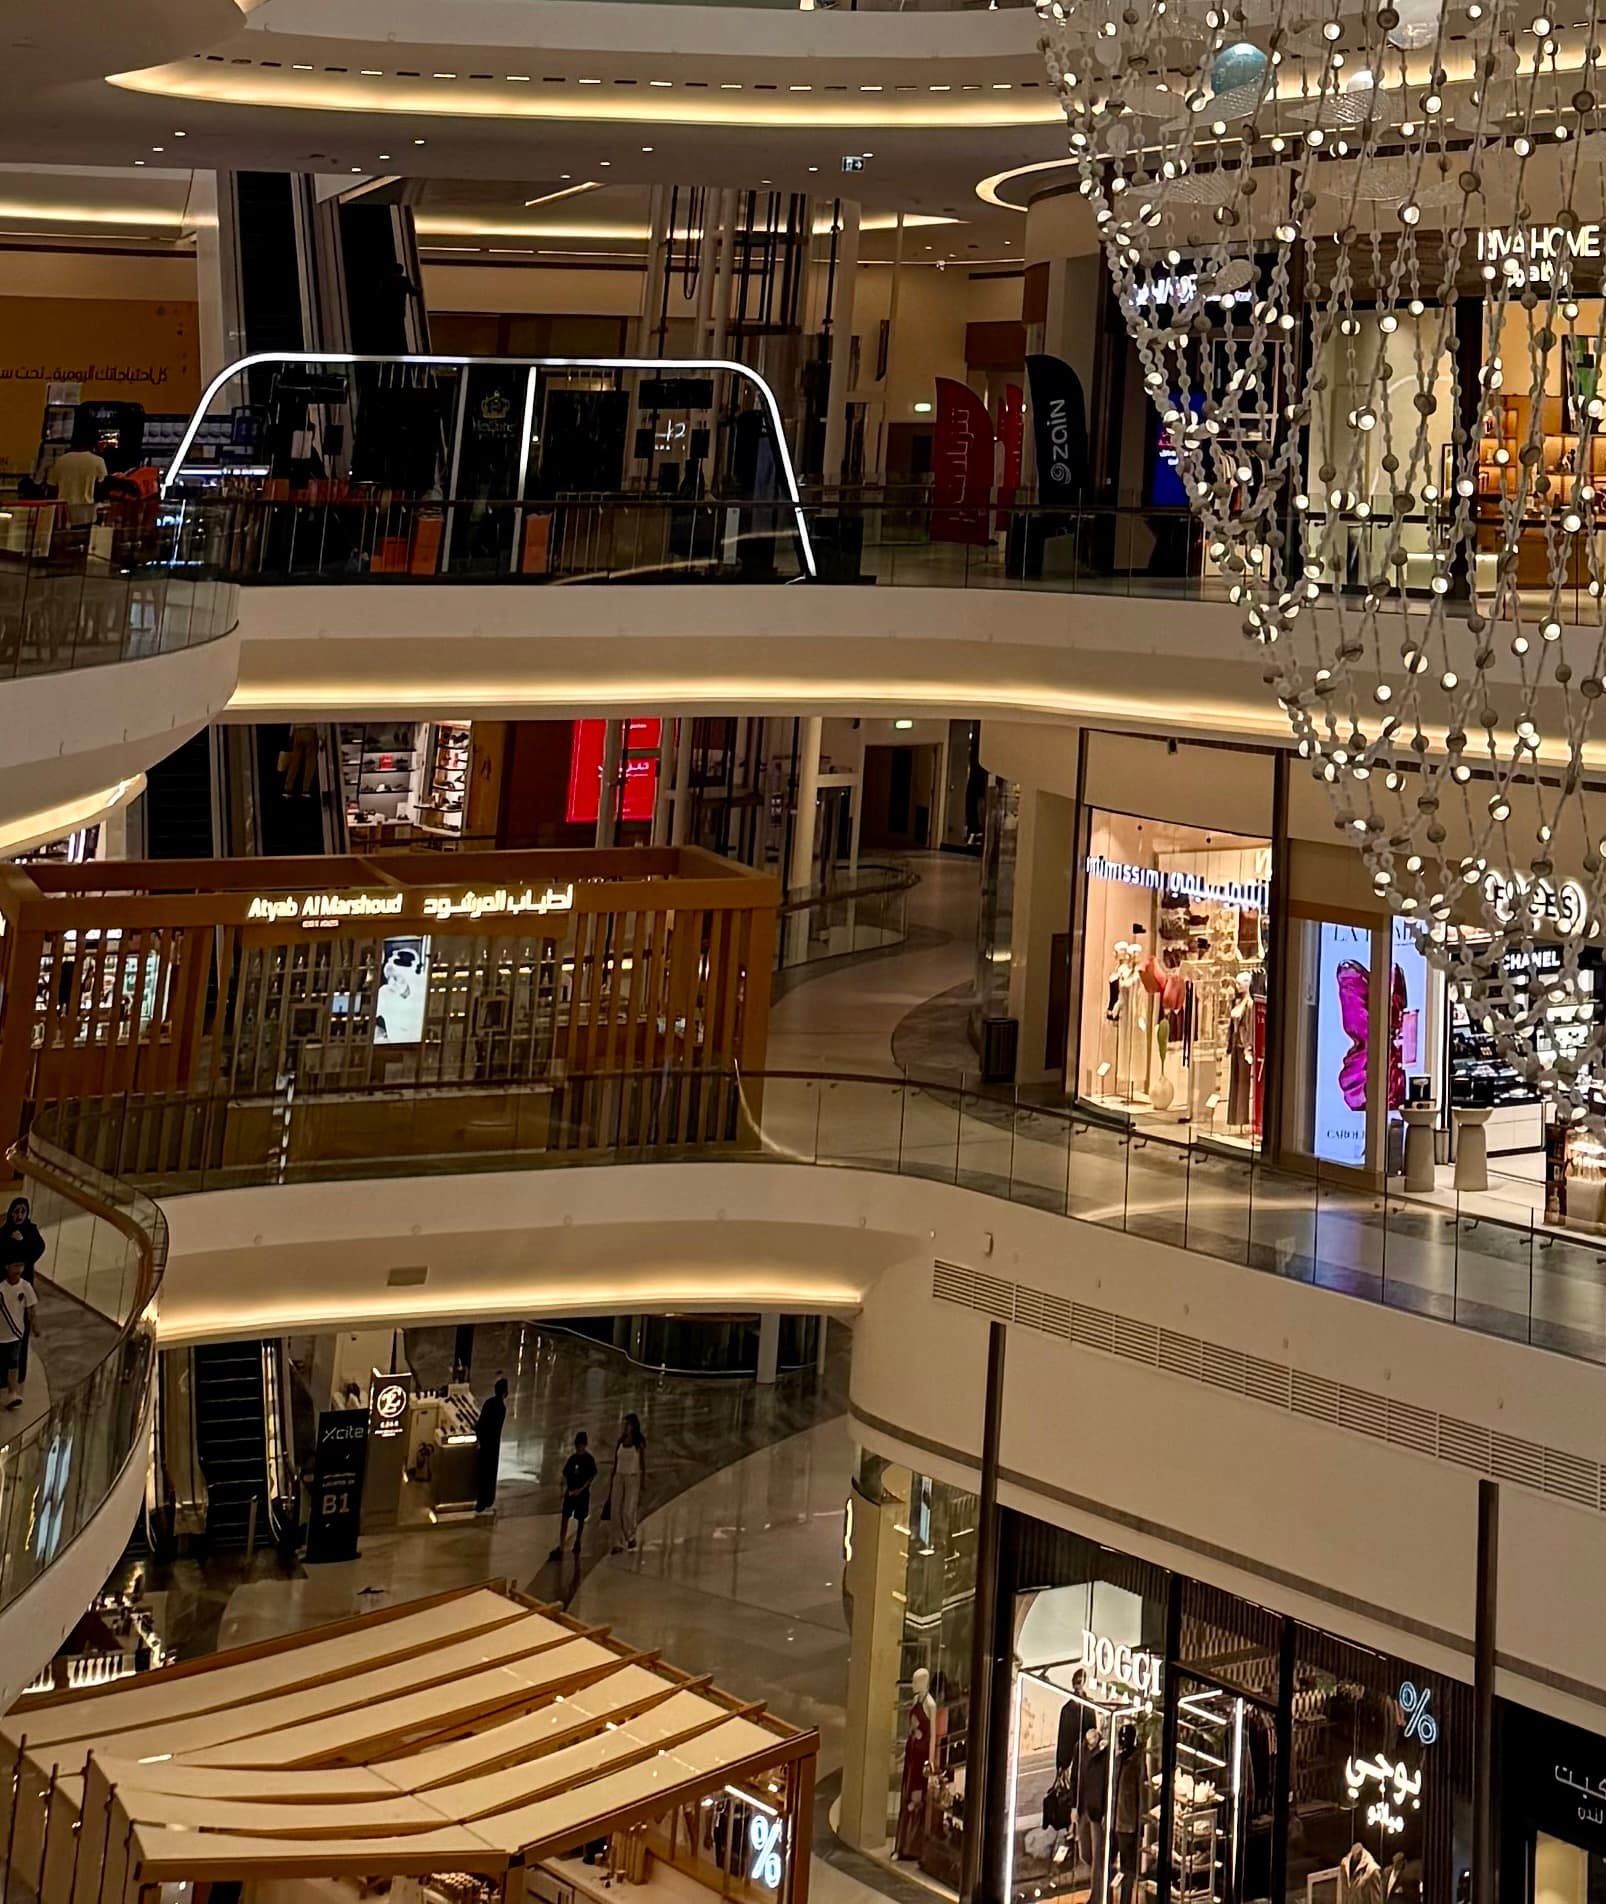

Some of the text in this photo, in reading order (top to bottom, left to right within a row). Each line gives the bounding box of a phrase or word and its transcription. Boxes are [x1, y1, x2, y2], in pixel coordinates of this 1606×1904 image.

[248, 897, 298, 922] Atyab
[1503, 950, 1560, 970] CHANEL
[322, 1493, 350, 1515] B1
[1082, 1629, 1163, 1697] BOGGI
